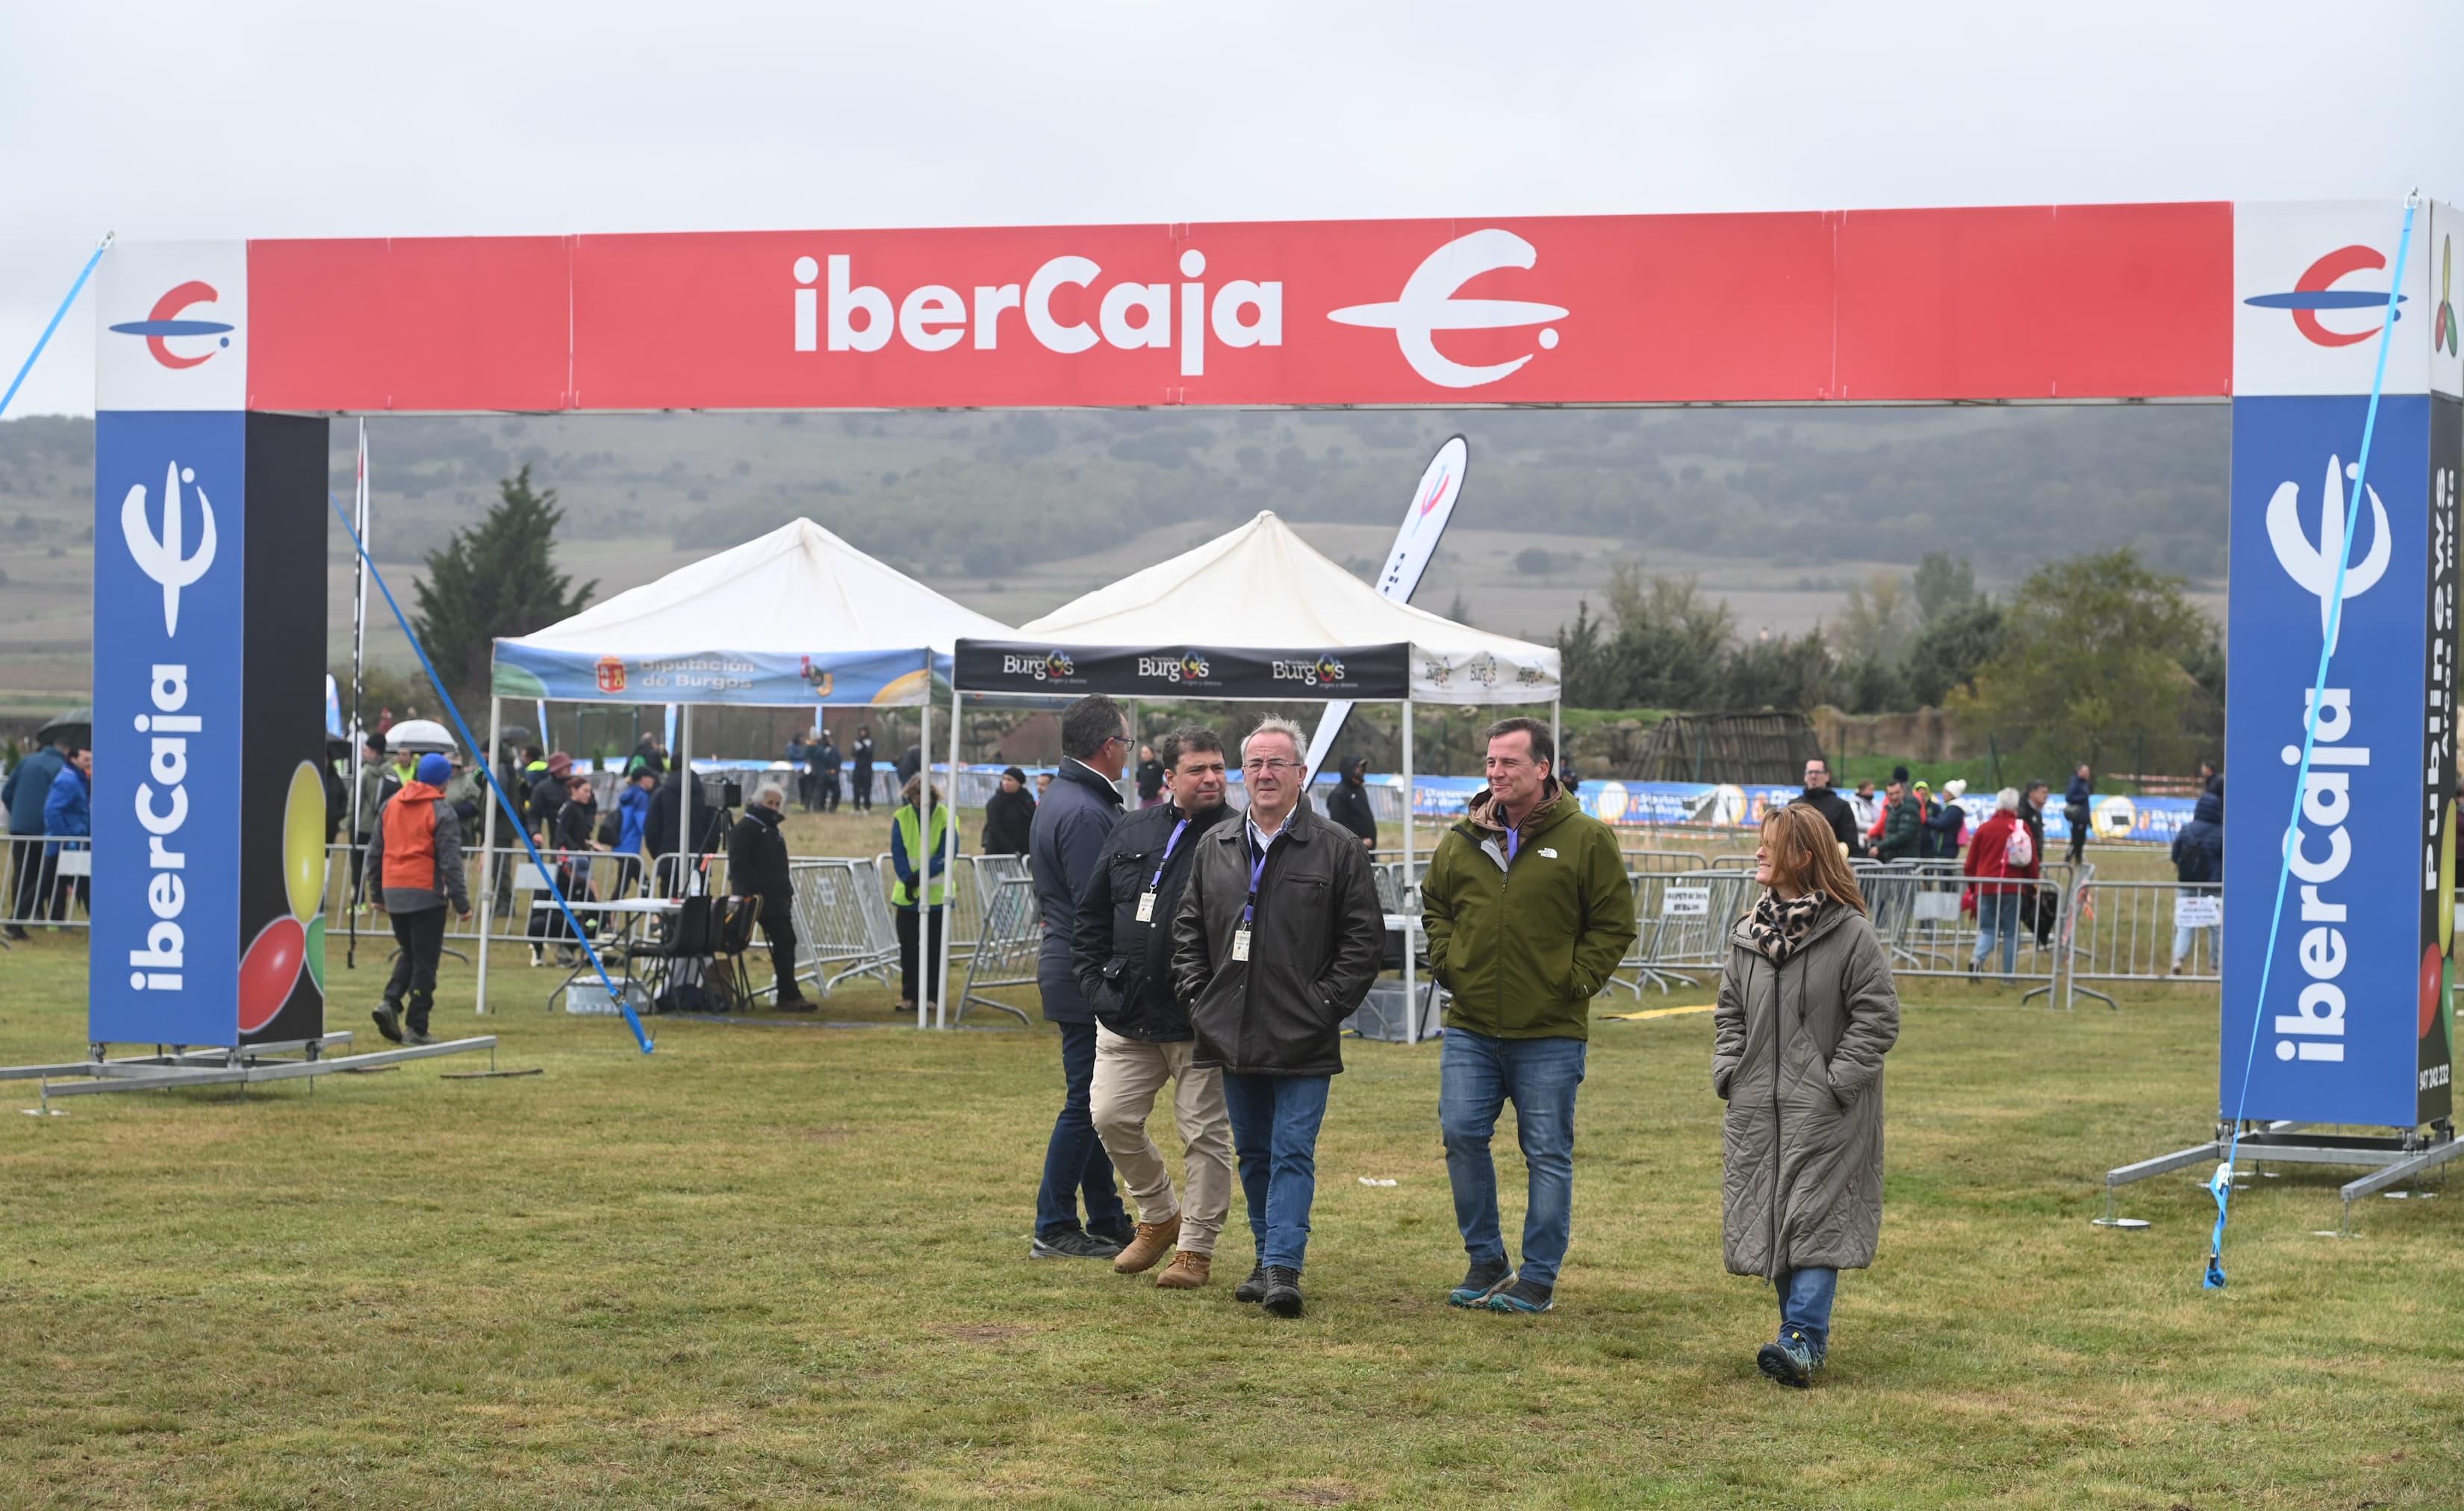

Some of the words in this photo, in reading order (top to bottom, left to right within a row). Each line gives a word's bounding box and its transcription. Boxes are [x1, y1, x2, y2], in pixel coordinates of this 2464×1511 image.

[793, 249, 1284, 377] iberCaja
[2445, 582, 2454, 630] de
[642, 674, 669, 688] de
[675, 674, 753, 691] Burgos
[1002, 648, 1075, 681] Burgos
[1137, 649, 1210, 683] Burgos
[1272, 652, 1345, 686] Burgos
[2425, 467, 2446, 891] Publinews
[2441, 644, 2452, 758] Arcos
[129, 663, 202, 991] iberCaja
[2274, 687, 2371, 1063] iberCaja
